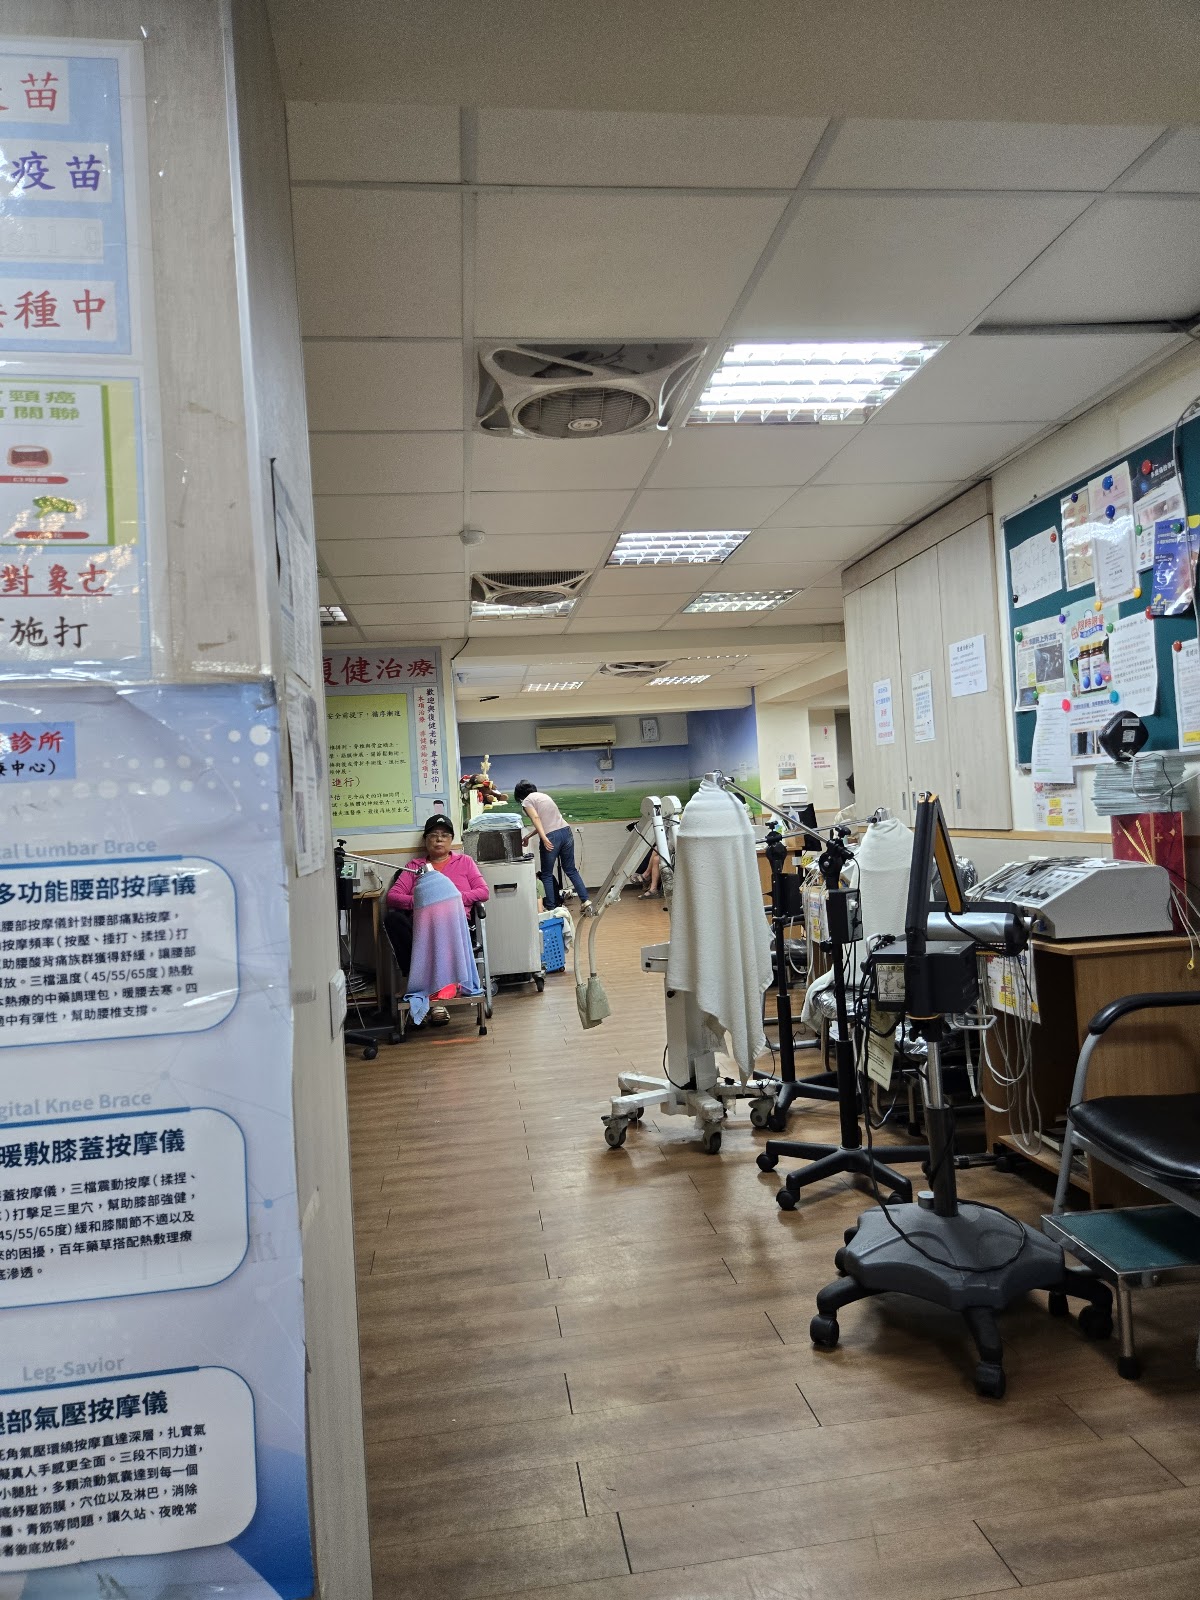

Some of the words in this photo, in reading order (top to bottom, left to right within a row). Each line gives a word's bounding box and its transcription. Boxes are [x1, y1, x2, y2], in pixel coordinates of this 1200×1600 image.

[0, 72, 59, 111] 苗
[11, 151, 104, 192] 疫苗
[0, 289, 106, 331] 種中
[0, 390, 76, 404] 頸癌
[0, 406, 80, 420] 關聯
[0, 616, 88, 648] 施打
[25, 839, 98, 859] Lumbar
[104, 838, 158, 855] Brace
[0, 874, 197, 905] 多功能腰部按摩儀
[0, 911, 180, 932] 腰部按摩儀針對腰部痛點按摩，
[0, 927, 189, 951] 按摩頻率(按壓、捶打、揉捏)打
[0, 946, 197, 970] 助腰酸背痛族群獲得舒緩，讓腰部
[0, 964, 194, 989] 放。三檔溫度(45/55/65度)熱敷
[0, 983, 198, 1008] 熱療的中藥調理包，暖腰去寒。四
[46, 1097, 97, 1114] Knee
[100, 1092, 152, 1109] Brace
[0, 1128, 186, 1169] 暖敷膝蓋按摩儀
[0, 1172, 196, 1202] 蓋按摩儀，三檔震動按摩(揉捏、
[0, 1191, 196, 1222] )打擊足三里穴，幫助膝部強健，
[22, 1355, 125, 1383] Leg-Savior
[0, 1390, 168, 1436] 部氣壓按摩儀
[0, 1537, 76, 1558] 者徹底放鬆。
